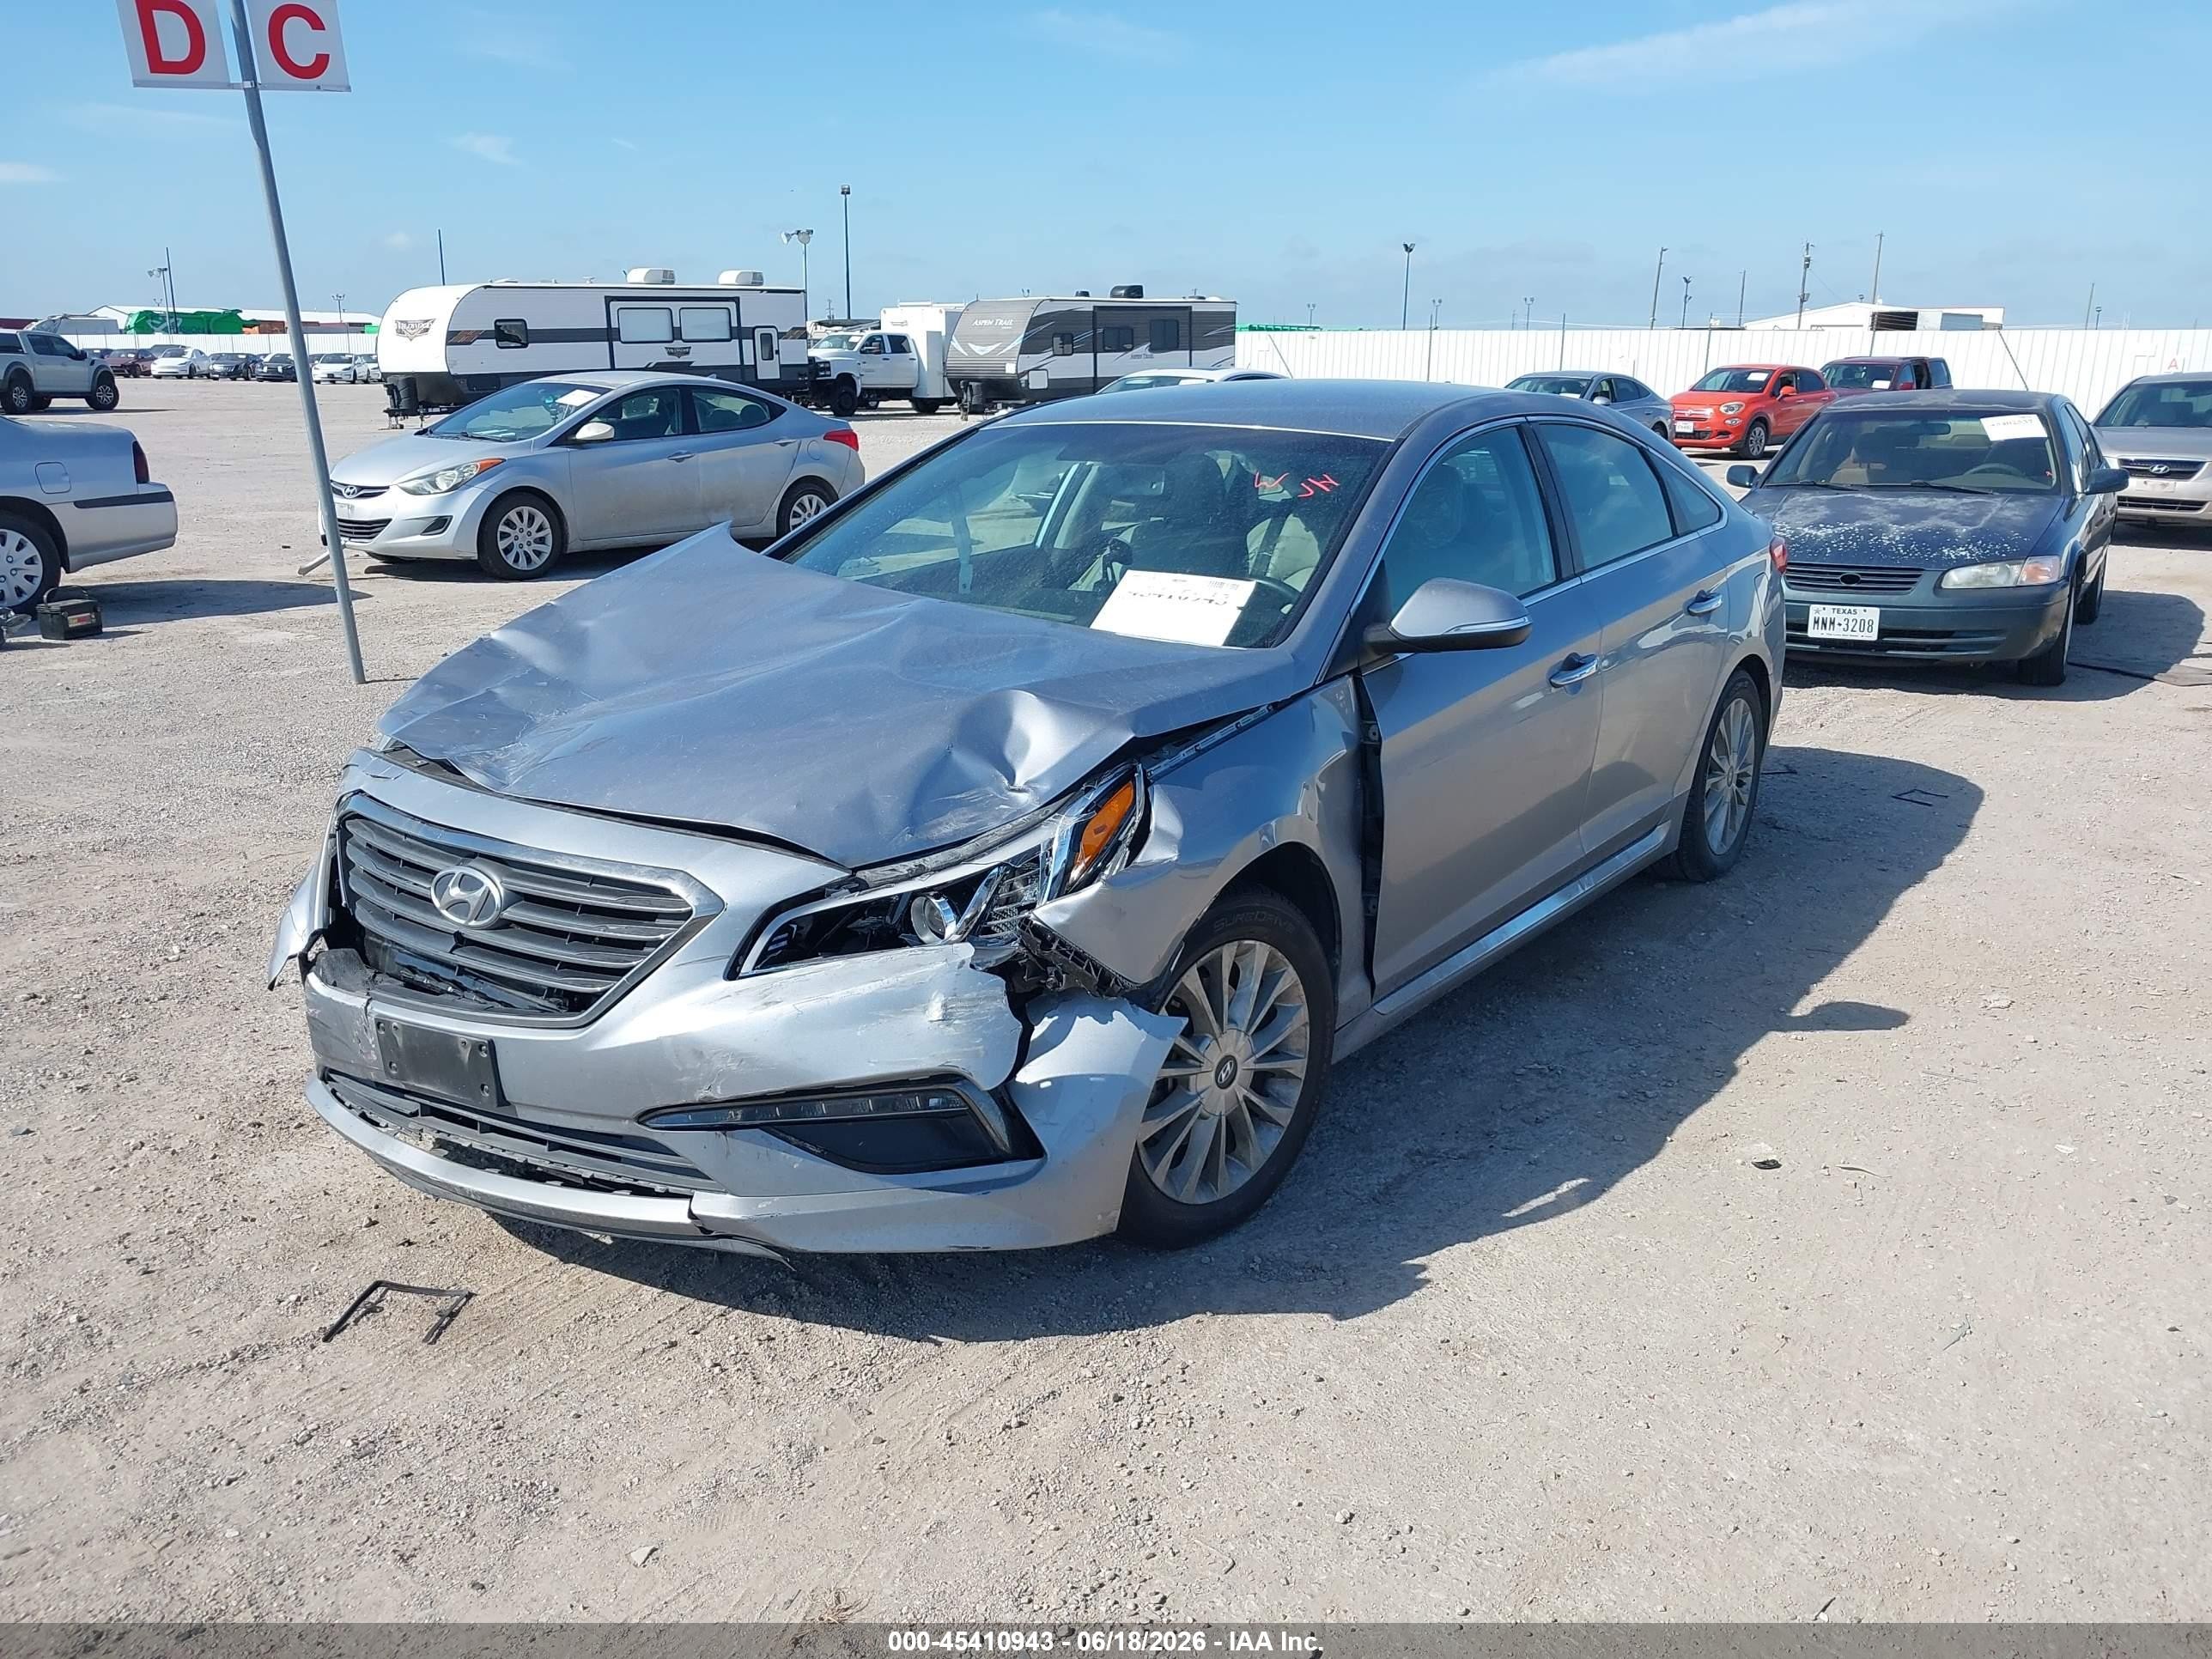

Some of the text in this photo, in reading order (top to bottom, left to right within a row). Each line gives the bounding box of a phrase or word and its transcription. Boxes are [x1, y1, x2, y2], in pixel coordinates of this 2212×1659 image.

[135, 0, 206, 75] D
[268, 3, 331, 79] C
[2167, 358, 2179, 370] A
